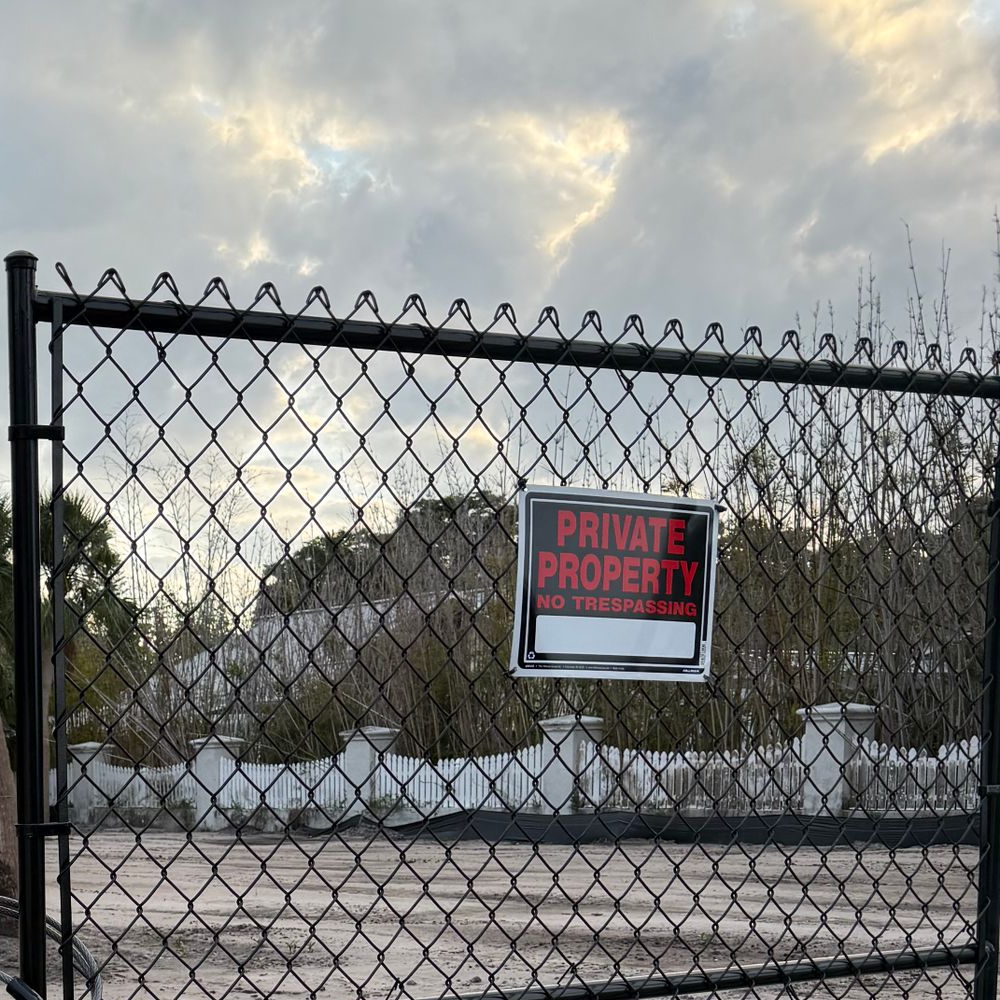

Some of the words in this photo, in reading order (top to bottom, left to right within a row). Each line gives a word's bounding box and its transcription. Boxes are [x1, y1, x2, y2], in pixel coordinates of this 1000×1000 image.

[557, 510, 686, 555] PRIVATE
[537, 551, 699, 597] PROPERTY
[536, 595, 565, 609] NO
[572, 596, 697, 617] TRESPASSING
